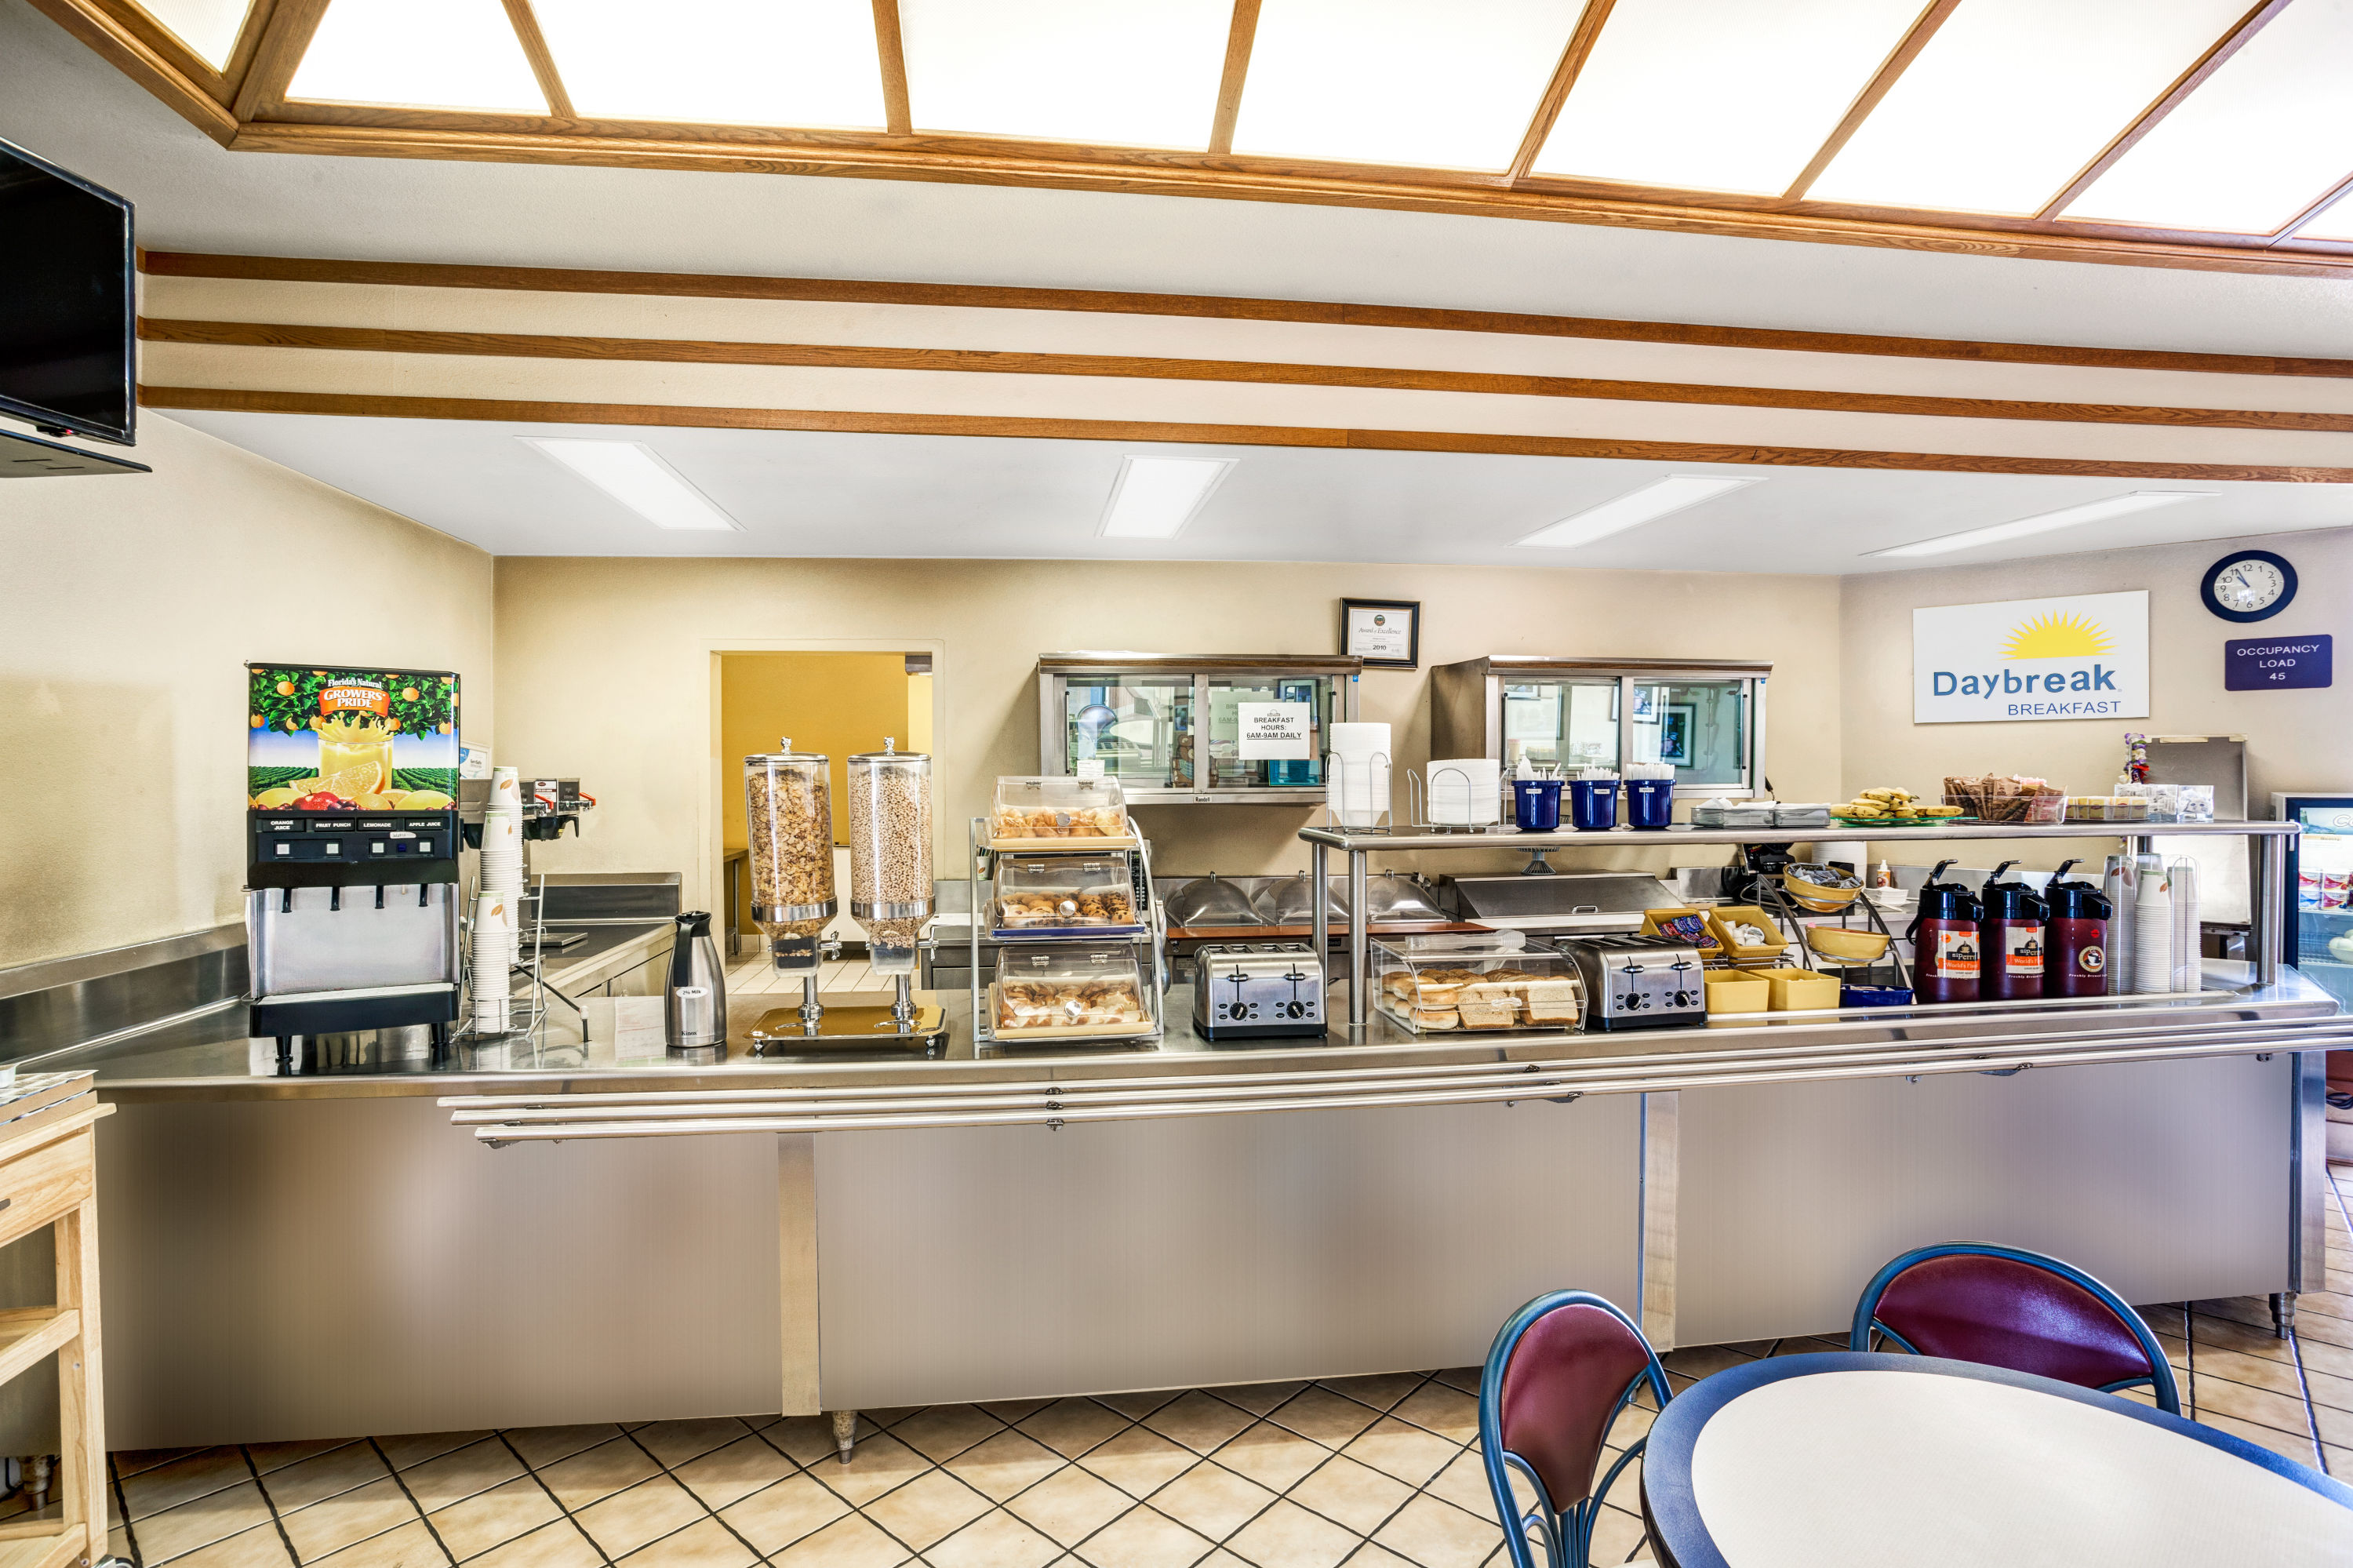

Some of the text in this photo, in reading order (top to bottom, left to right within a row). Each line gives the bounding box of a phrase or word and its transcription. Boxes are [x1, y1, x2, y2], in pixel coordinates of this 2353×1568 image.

[2237, 644, 2320, 657] OCCUPANCY
[2259, 659, 2296, 668] LOAD
[357, 678, 384, 689] Natural
[1933, 664, 2117, 700] Daybreak
[337, 697, 373, 708] PRIDE
[2008, 700, 2122, 715] BREAKFAST
